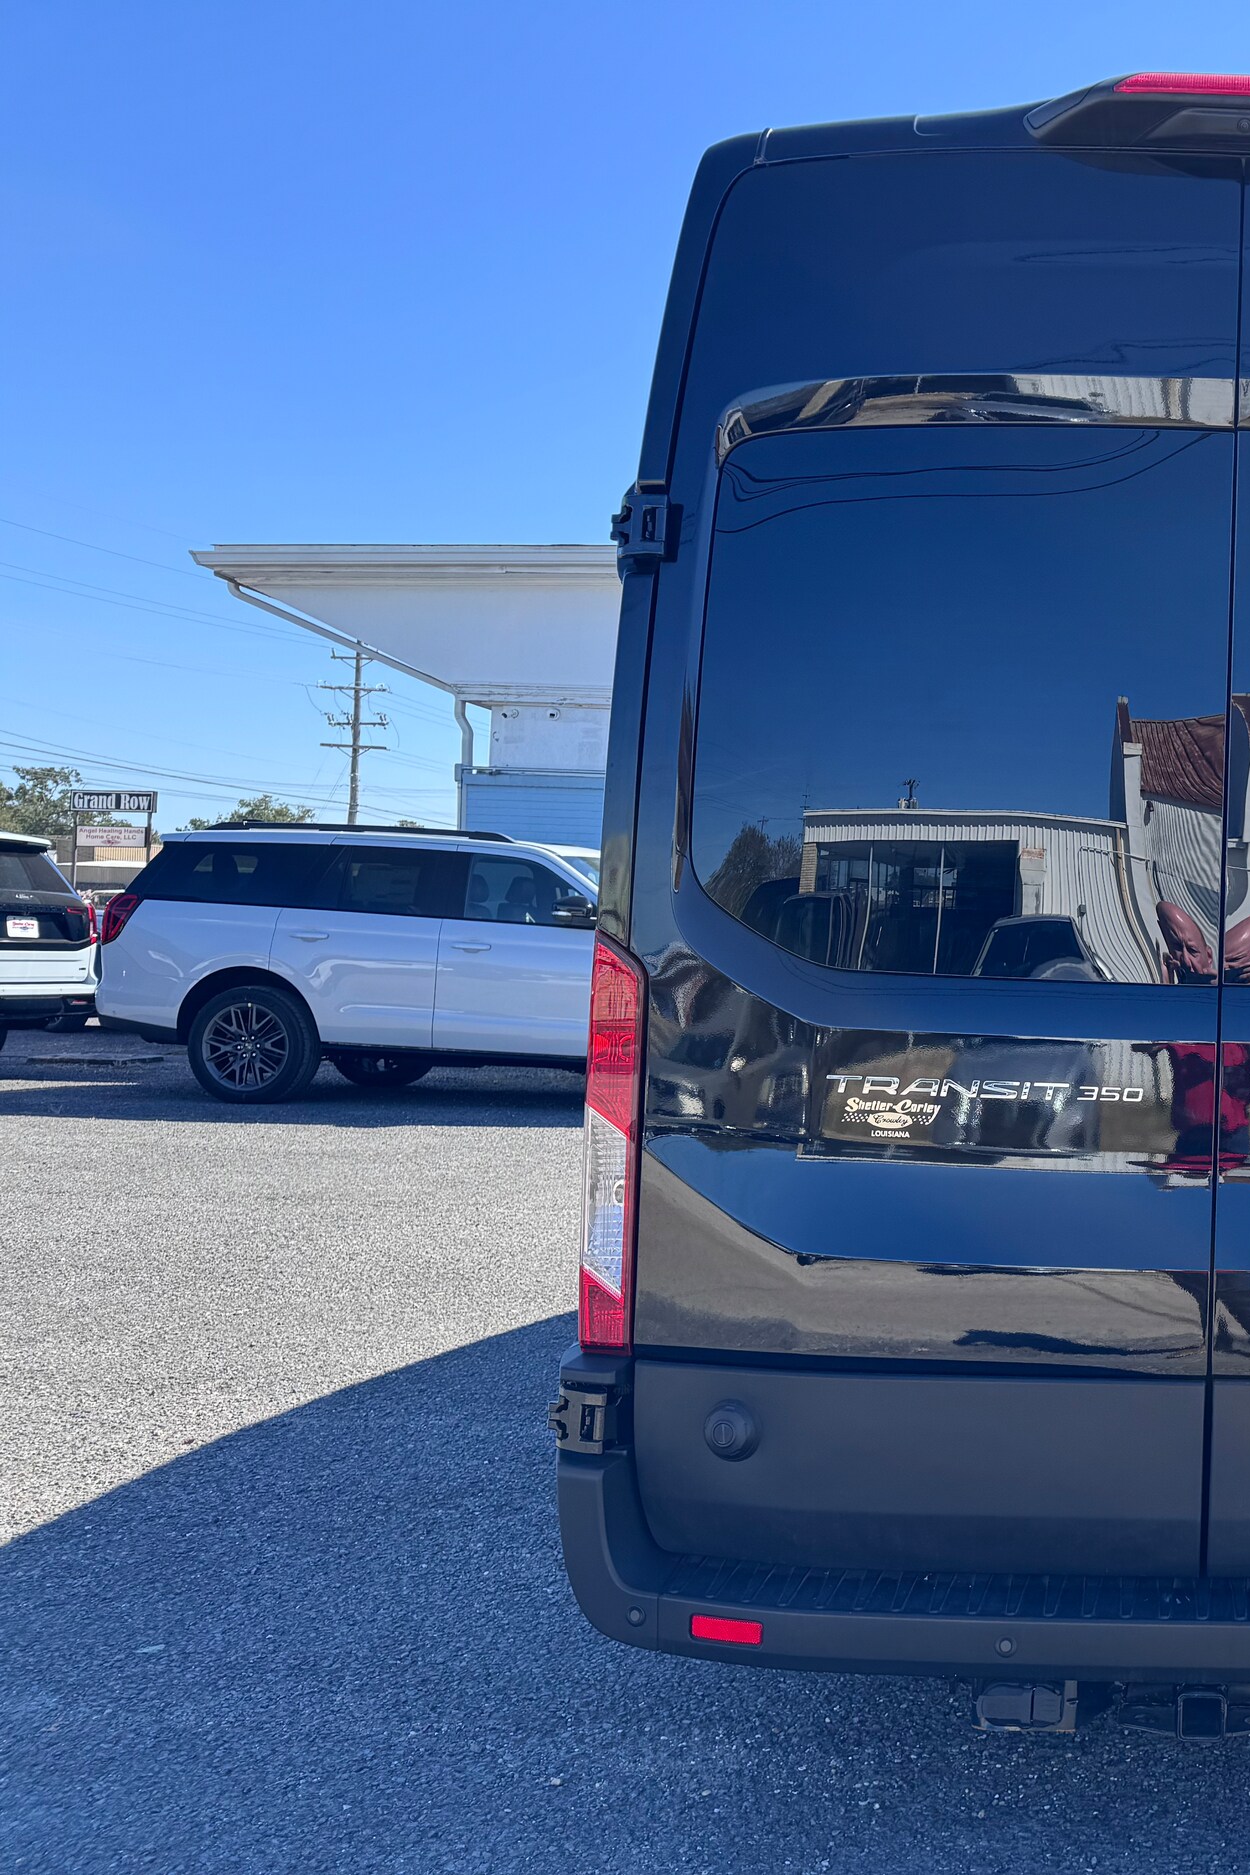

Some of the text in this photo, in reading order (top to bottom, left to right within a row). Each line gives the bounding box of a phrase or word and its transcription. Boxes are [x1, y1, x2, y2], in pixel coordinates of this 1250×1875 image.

[74, 792, 150, 810] Grand Row
[826, 1074, 1145, 1103] TRANSIT 350
[871, 1130, 910, 1138] LOUISIANA
